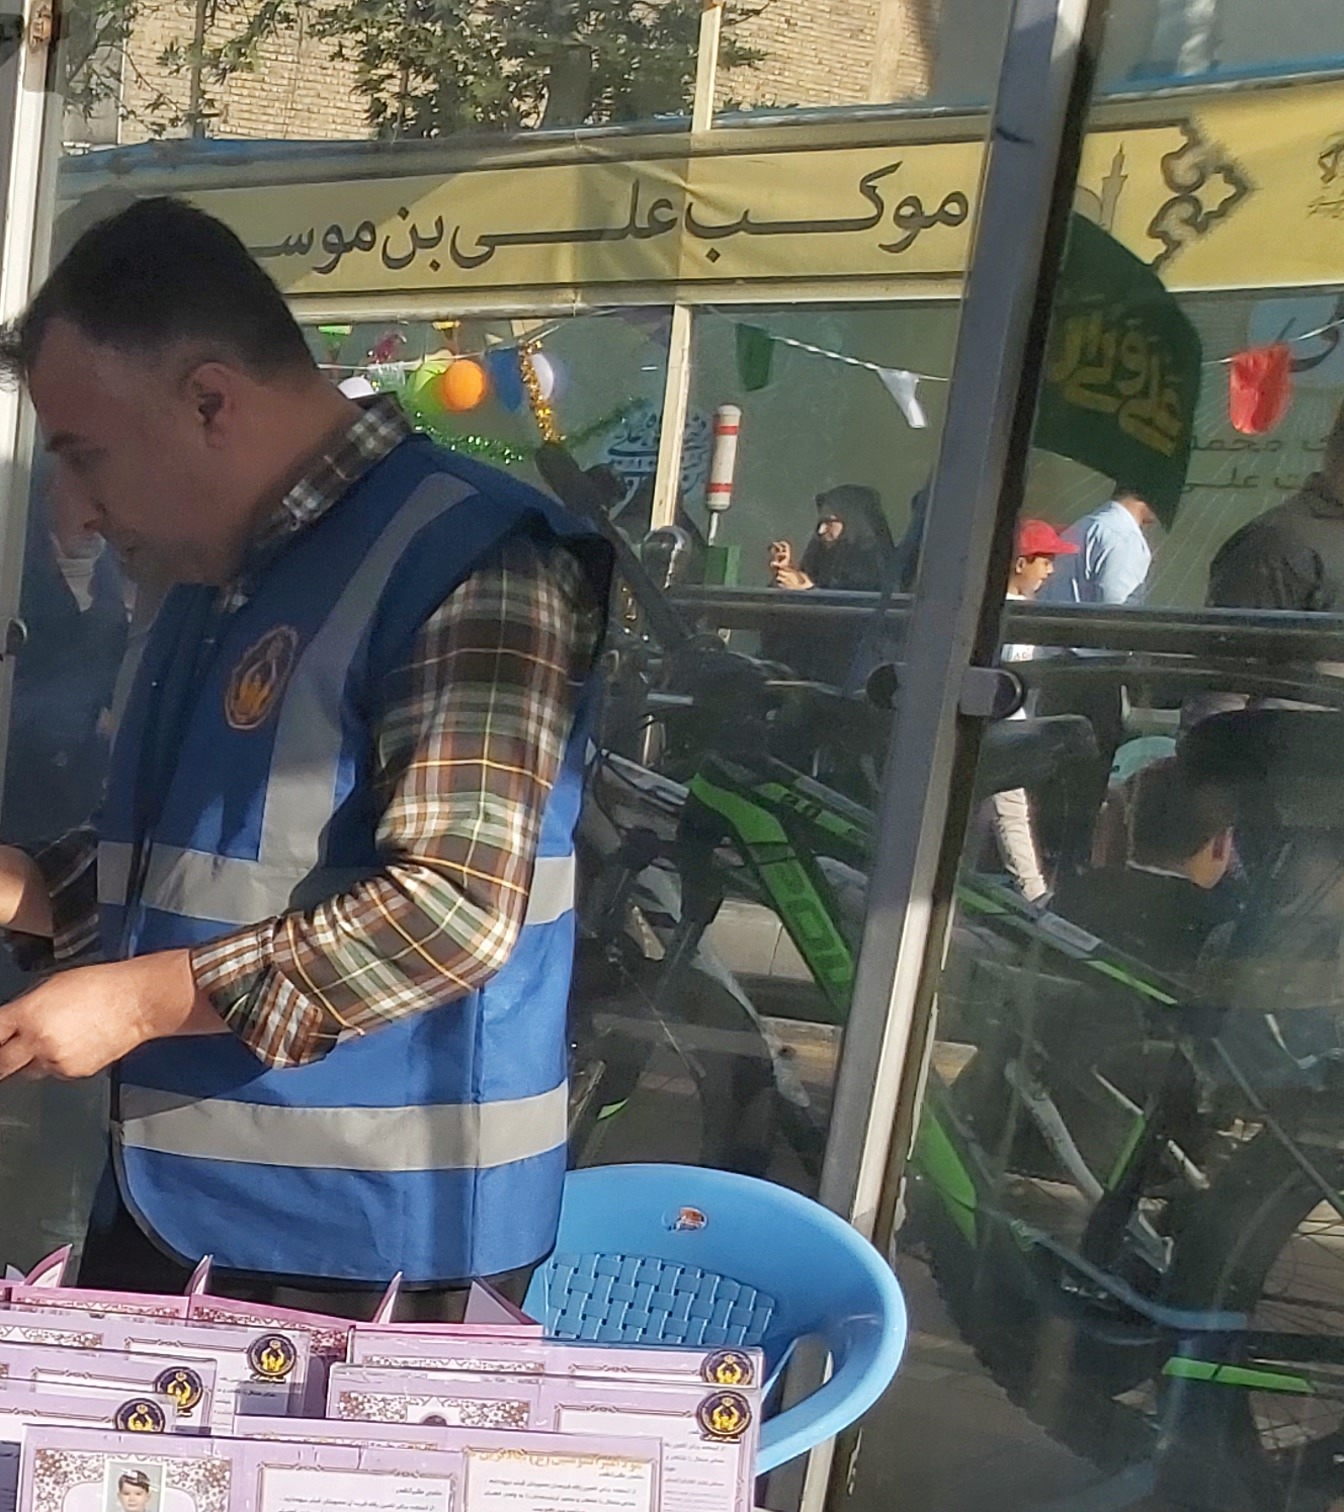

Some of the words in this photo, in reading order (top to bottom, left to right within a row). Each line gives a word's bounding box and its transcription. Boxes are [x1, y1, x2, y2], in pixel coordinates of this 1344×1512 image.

[382, 206, 444, 273] بن
[450, 180, 683, 270] علی
[684, 160, 971, 263] موکب
